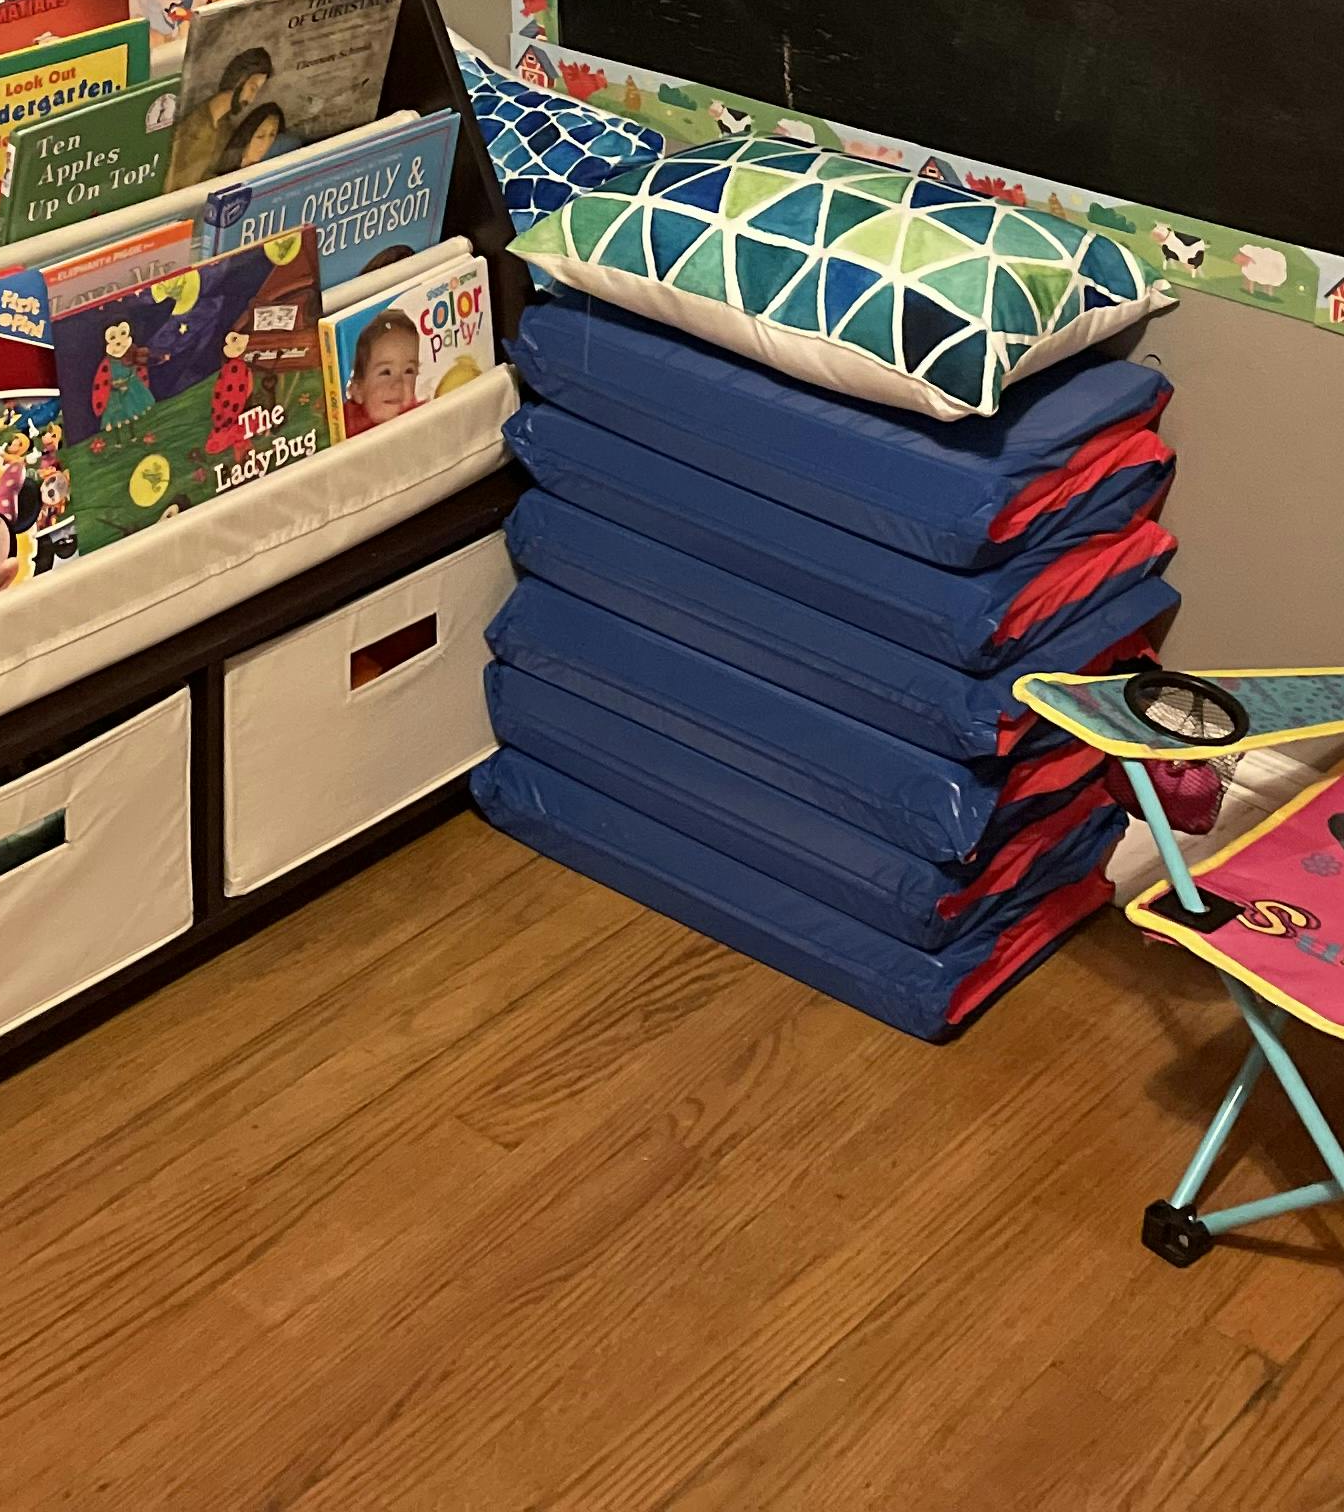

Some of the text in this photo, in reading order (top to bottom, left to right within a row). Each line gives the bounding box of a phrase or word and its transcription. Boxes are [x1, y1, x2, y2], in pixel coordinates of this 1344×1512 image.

[288, 15, 308, 29] OF
[6, 67, 76, 97] Look Out
[36, 133, 81, 159] Ten
[38, 146, 121, 187] Apples
[27, 154, 159, 222] Up On Top!
[240, 205, 286, 248] BILL
[407, 156, 425, 188] &
[420, 285, 482, 336] color
[430, 312, 483, 363] party!
[238, 404, 285, 440] The
